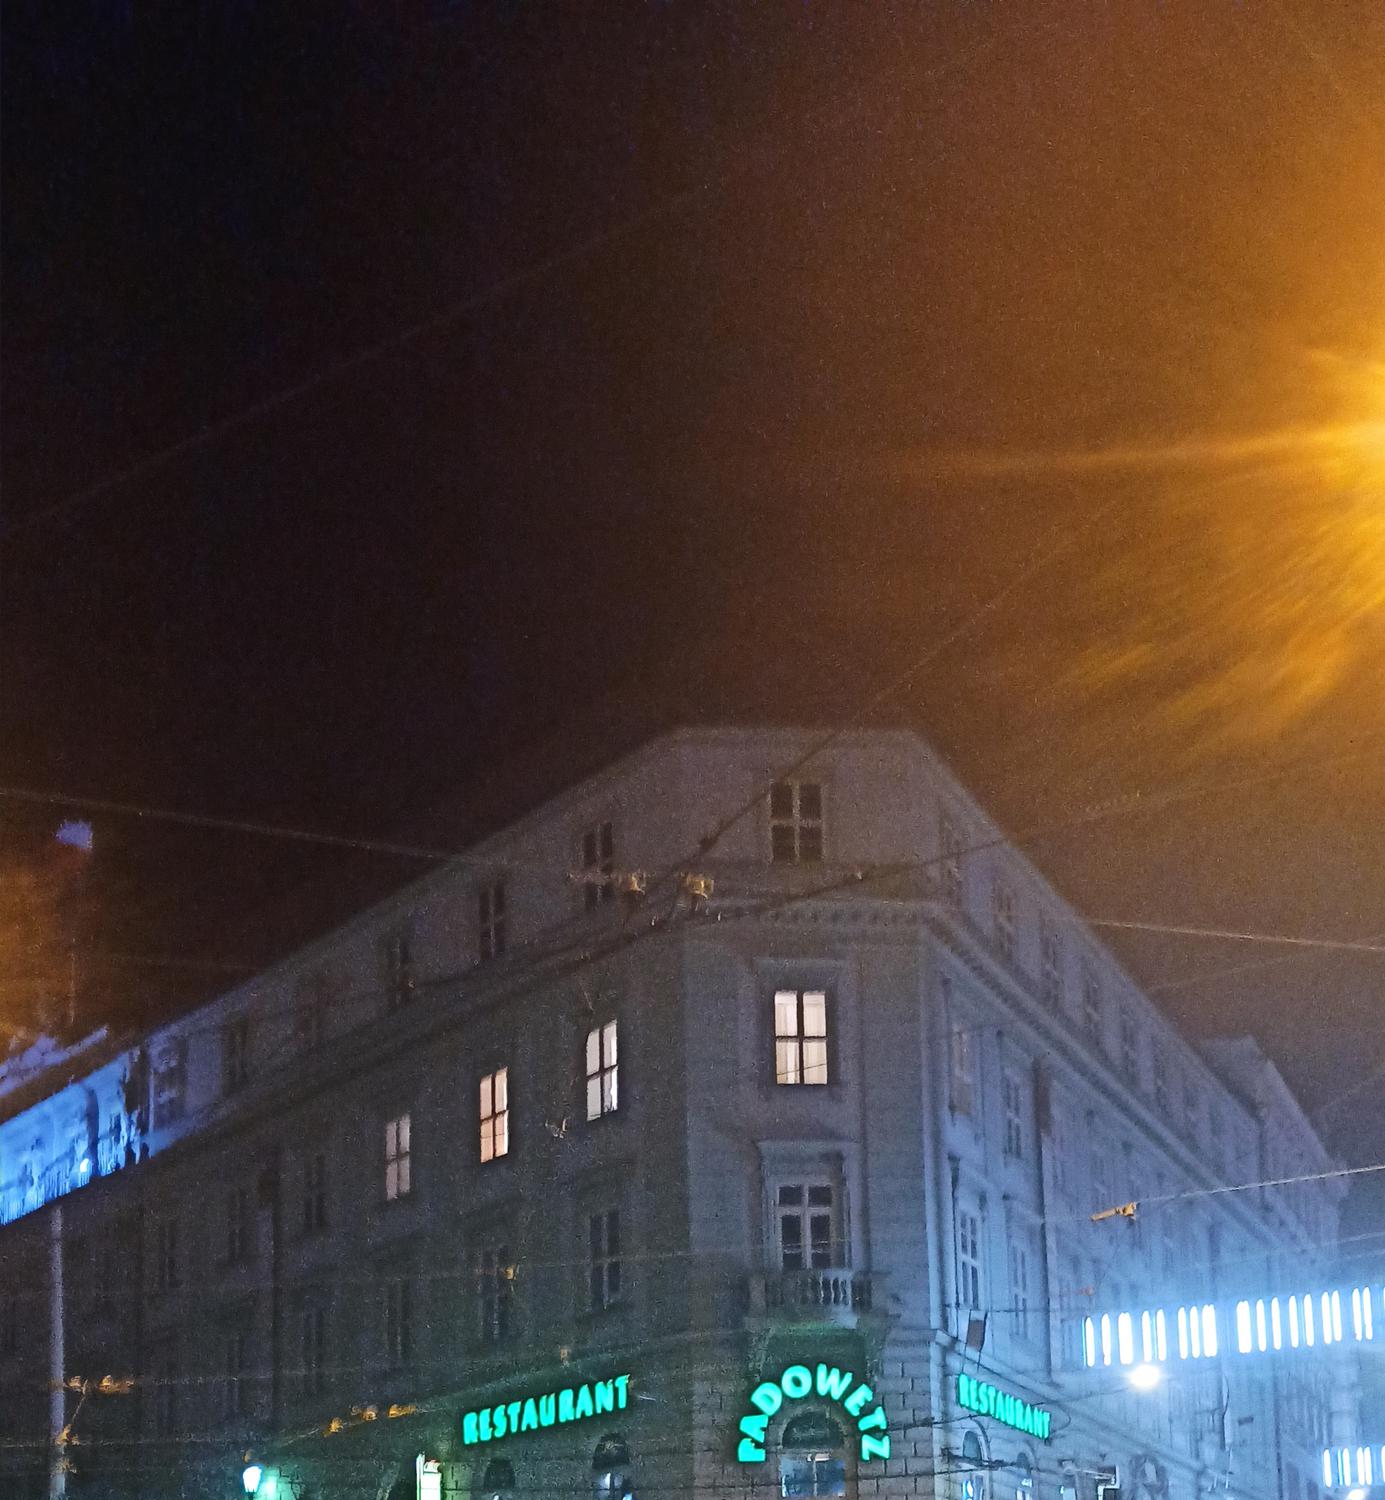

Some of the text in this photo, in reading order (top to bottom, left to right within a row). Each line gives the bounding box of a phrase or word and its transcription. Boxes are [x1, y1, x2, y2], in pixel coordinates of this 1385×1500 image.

[463, 1375, 629, 1445] RESTAURANT
[737, 1363, 891, 1462] PADOWETZ
[957, 1372, 1051, 1440] RESTAURANT
